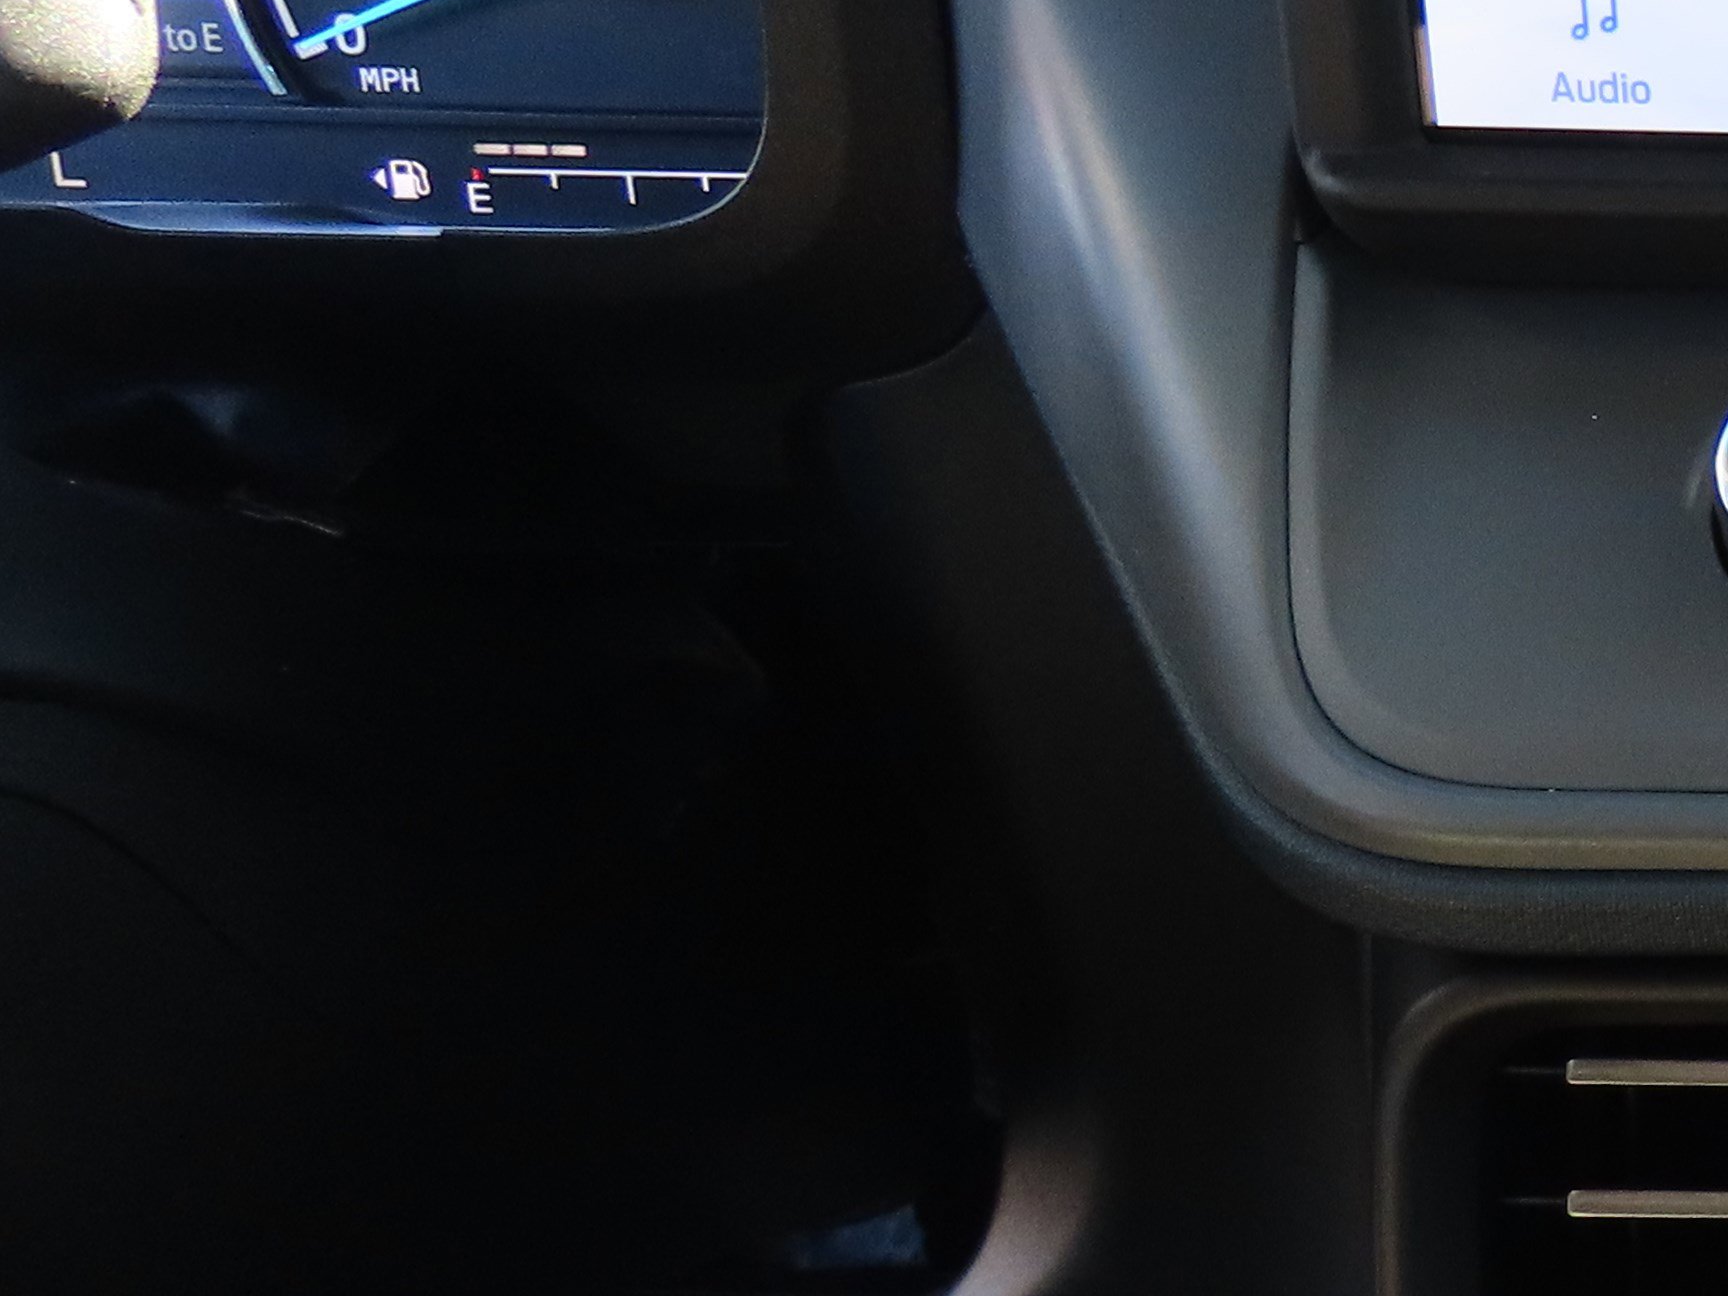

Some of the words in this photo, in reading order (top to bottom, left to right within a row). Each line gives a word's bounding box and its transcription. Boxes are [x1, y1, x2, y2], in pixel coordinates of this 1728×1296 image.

[165, 25, 197, 51] to
[203, 23, 223, 53] E
[359, 67, 420, 93] MPH
[1552, 71, 1652, 105] Audio
[466, 182, 494, 213] E
